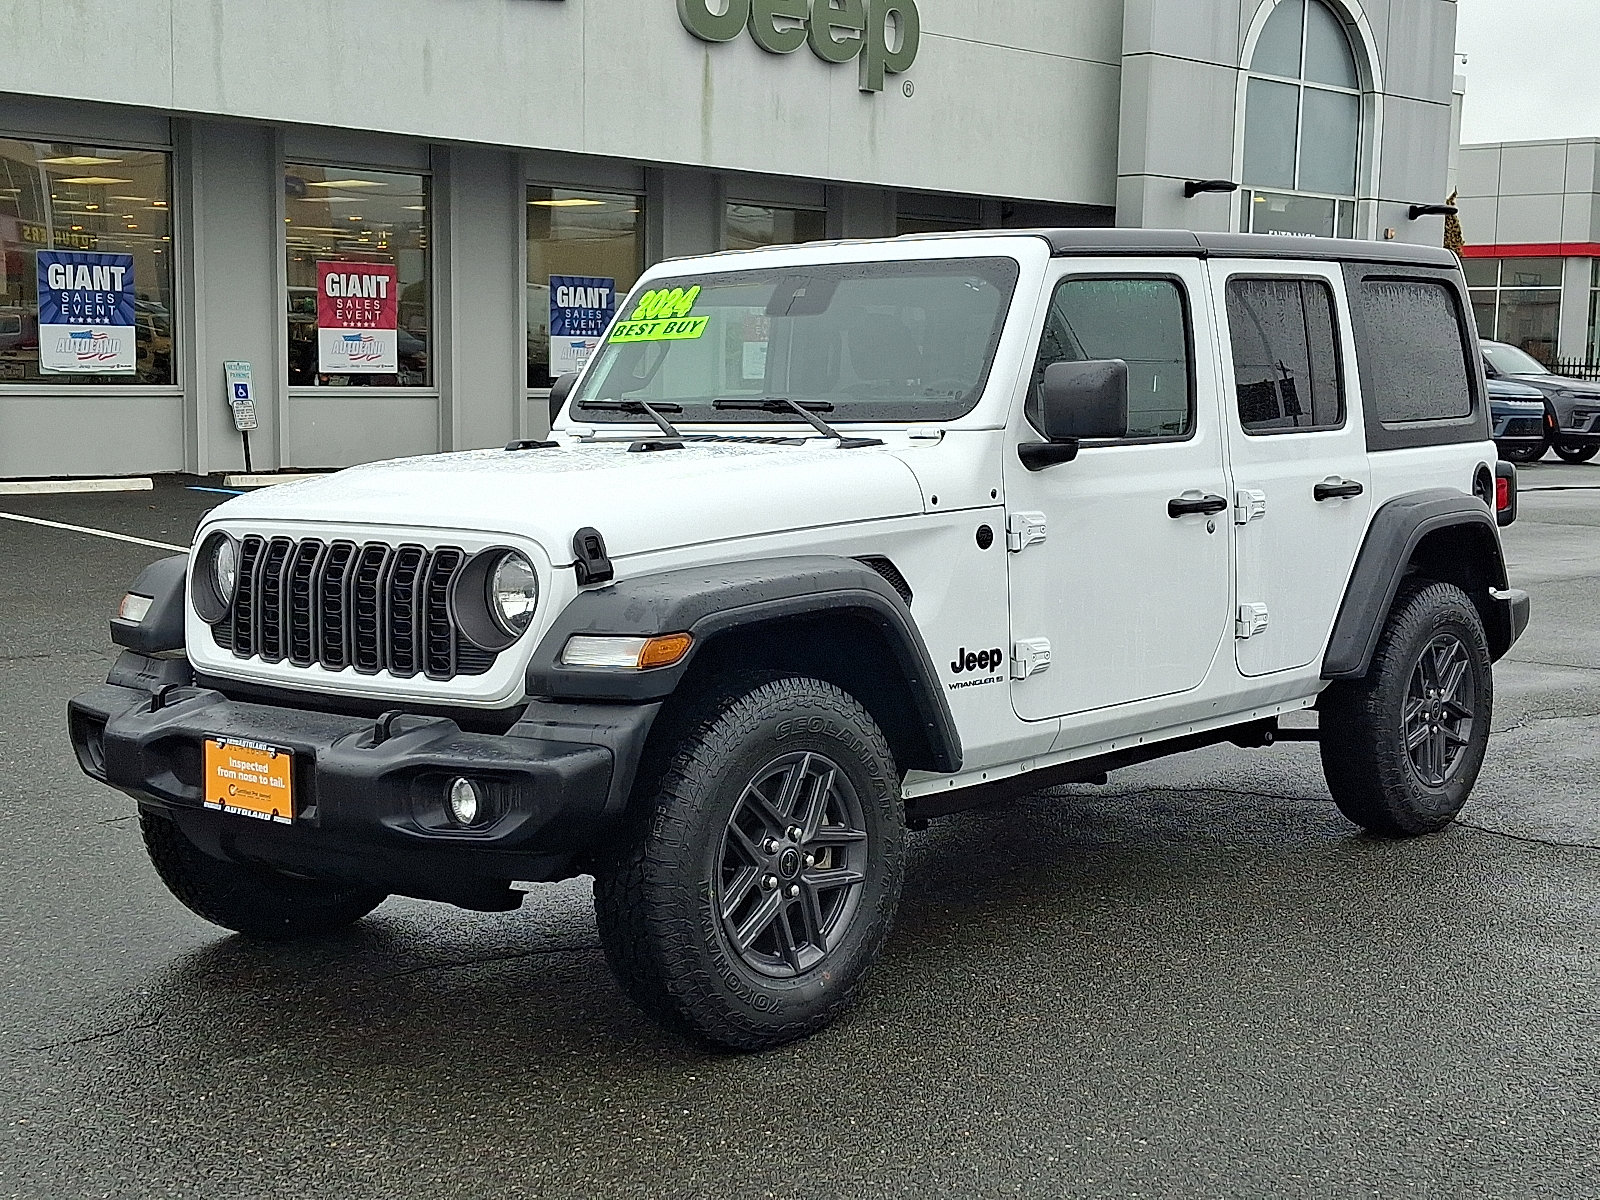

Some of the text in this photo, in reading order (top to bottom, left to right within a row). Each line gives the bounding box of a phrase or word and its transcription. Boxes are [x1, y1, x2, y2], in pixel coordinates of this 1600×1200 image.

[48, 263, 126, 292] GIANT
[325, 272, 390, 299] GIANT
[61, 291, 115, 304] SALES
[336, 298, 380, 310] SALES
[556, 286, 610, 309] GIANT
[631, 285, 701, 321] 2024
[61, 304, 116, 316] EVENT
[336, 310, 381, 321] EVENT
[565, 309, 602, 319] SALES
[564, 319, 602, 329] EVENT
[613, 319, 703, 337] BEST BUY
[951, 647, 1003, 674] Jeep
[948, 677, 995, 691] WRANGLER
[229, 757, 269, 774] Inspected
[217, 766, 286, 789] from nose to tail.
[224, 805, 272, 820] AUTOLAND
